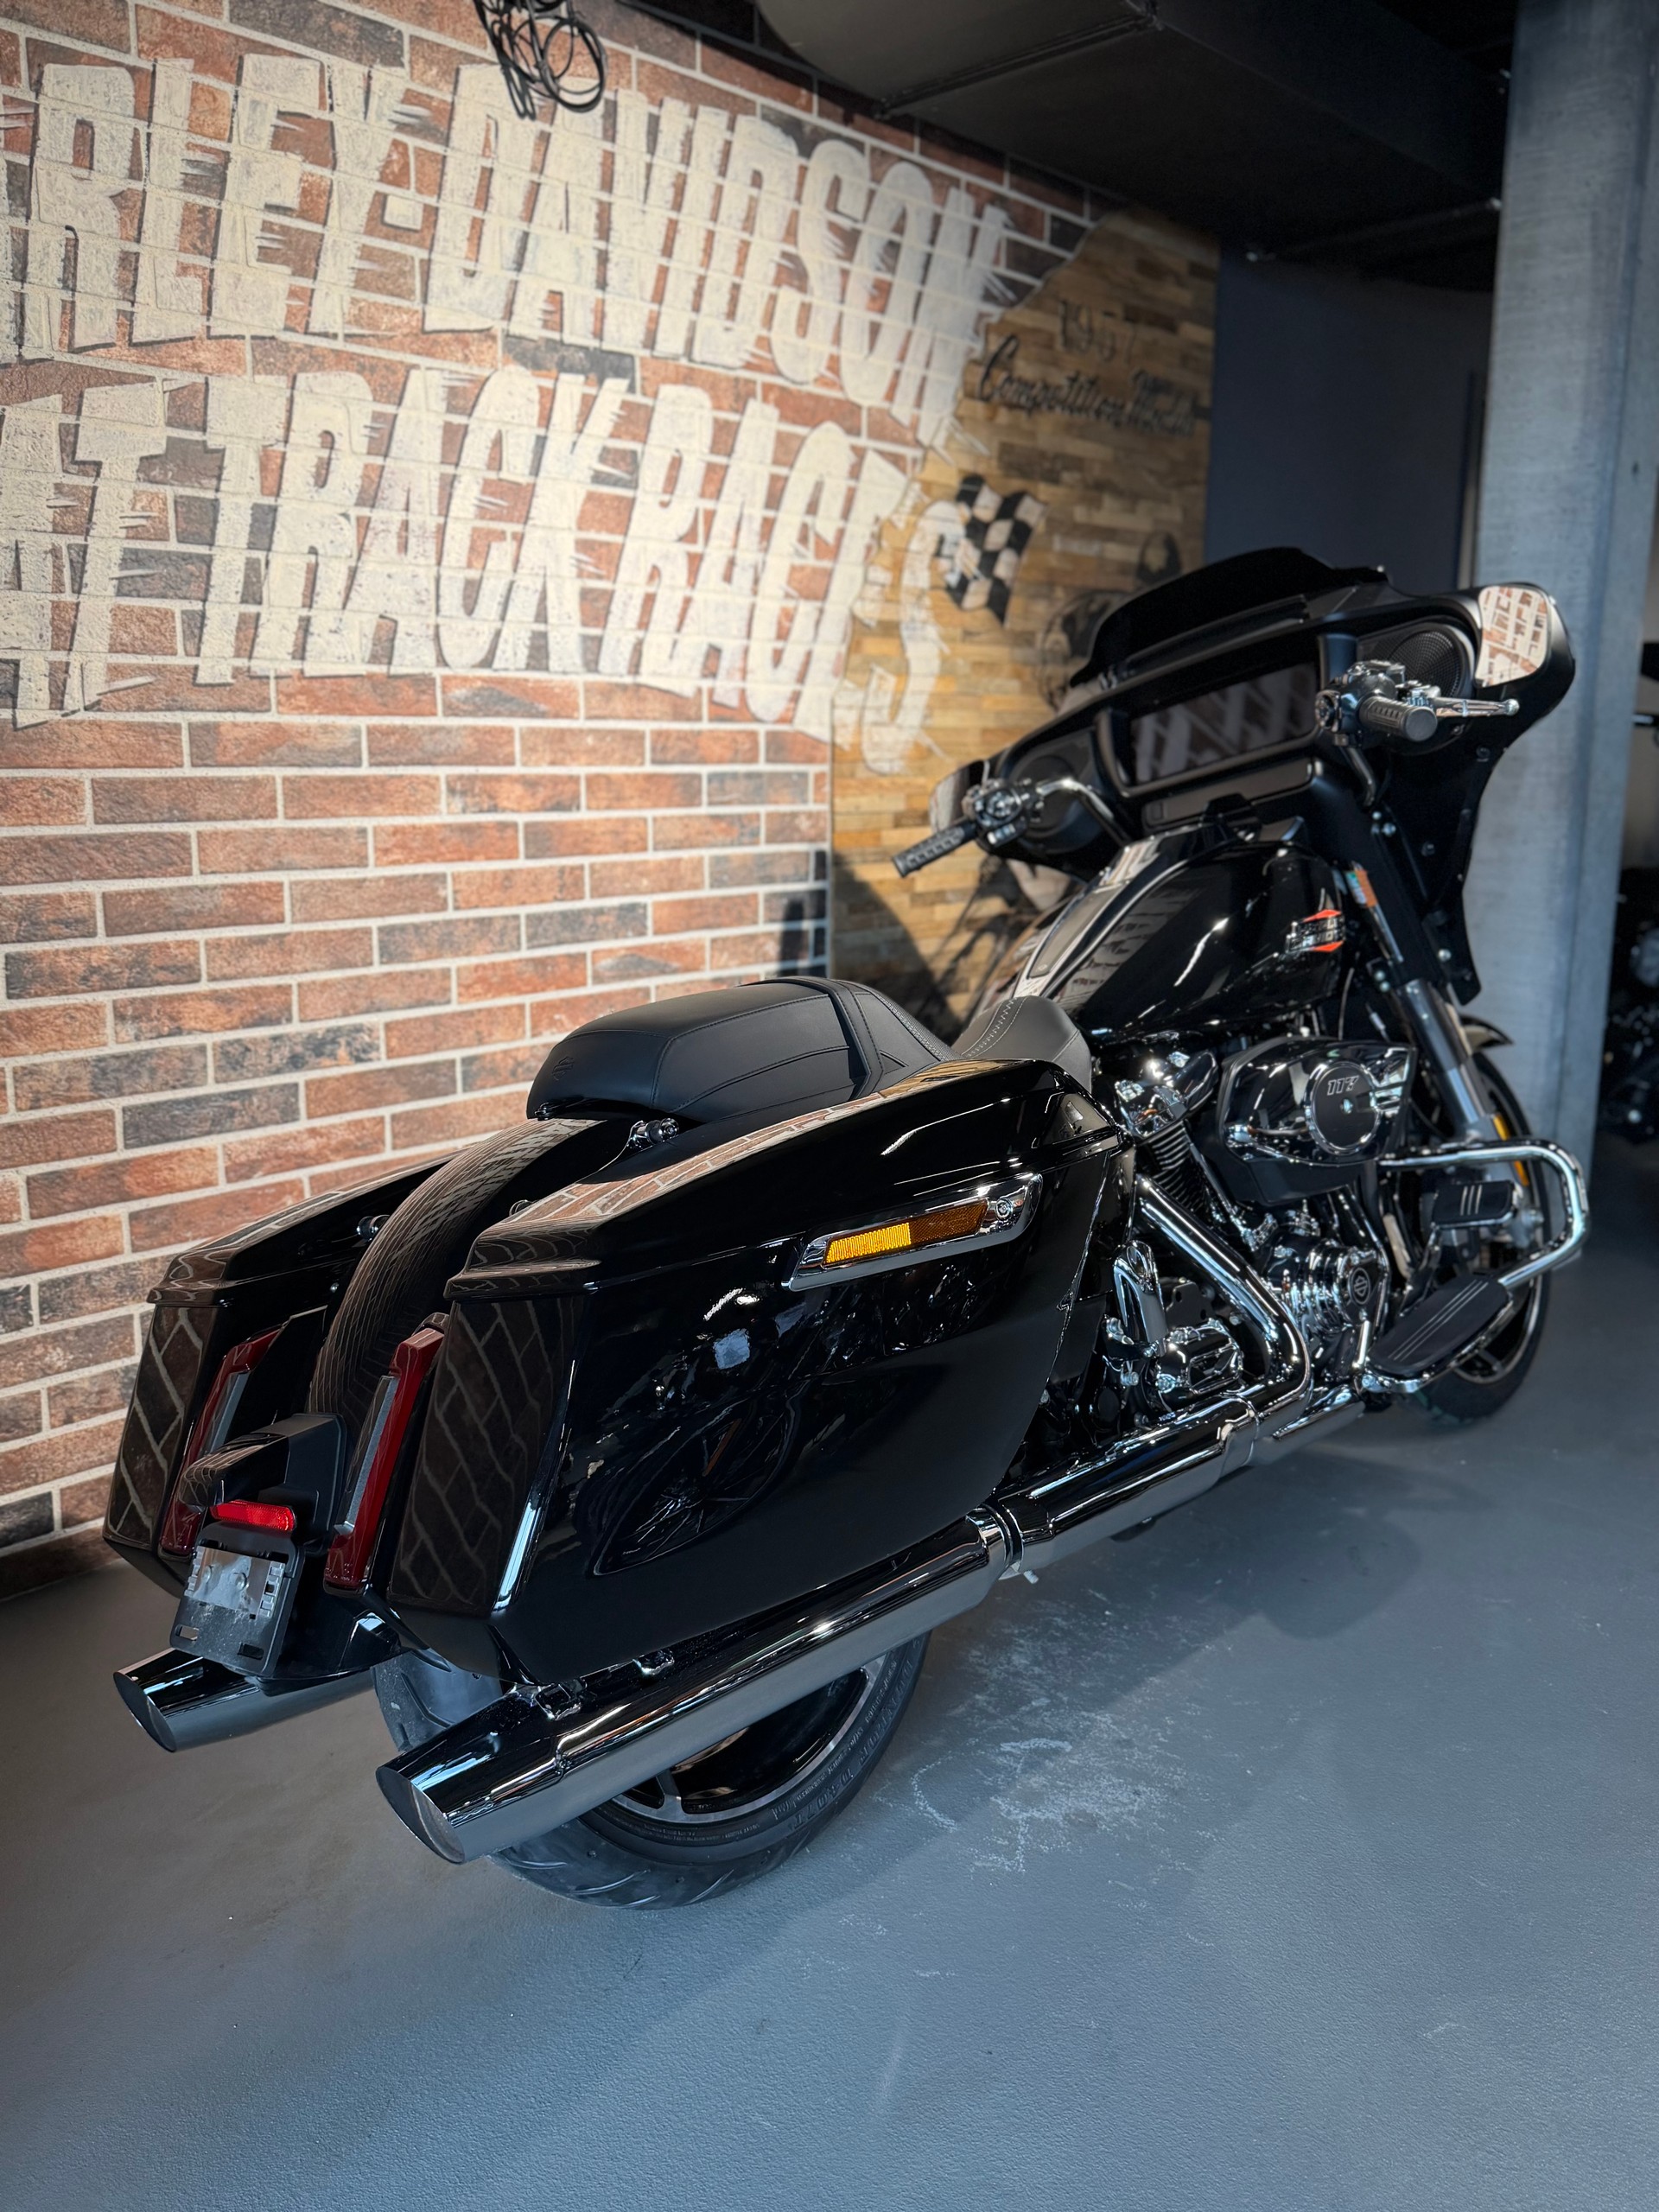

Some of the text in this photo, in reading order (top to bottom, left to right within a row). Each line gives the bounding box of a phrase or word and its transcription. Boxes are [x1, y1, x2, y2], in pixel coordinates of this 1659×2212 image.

[0, 52, 1013, 454] RLEY-DAVIDSON
[194, 365, 638, 688] TRACK
[1327, 1075, 1360, 1096] 117
